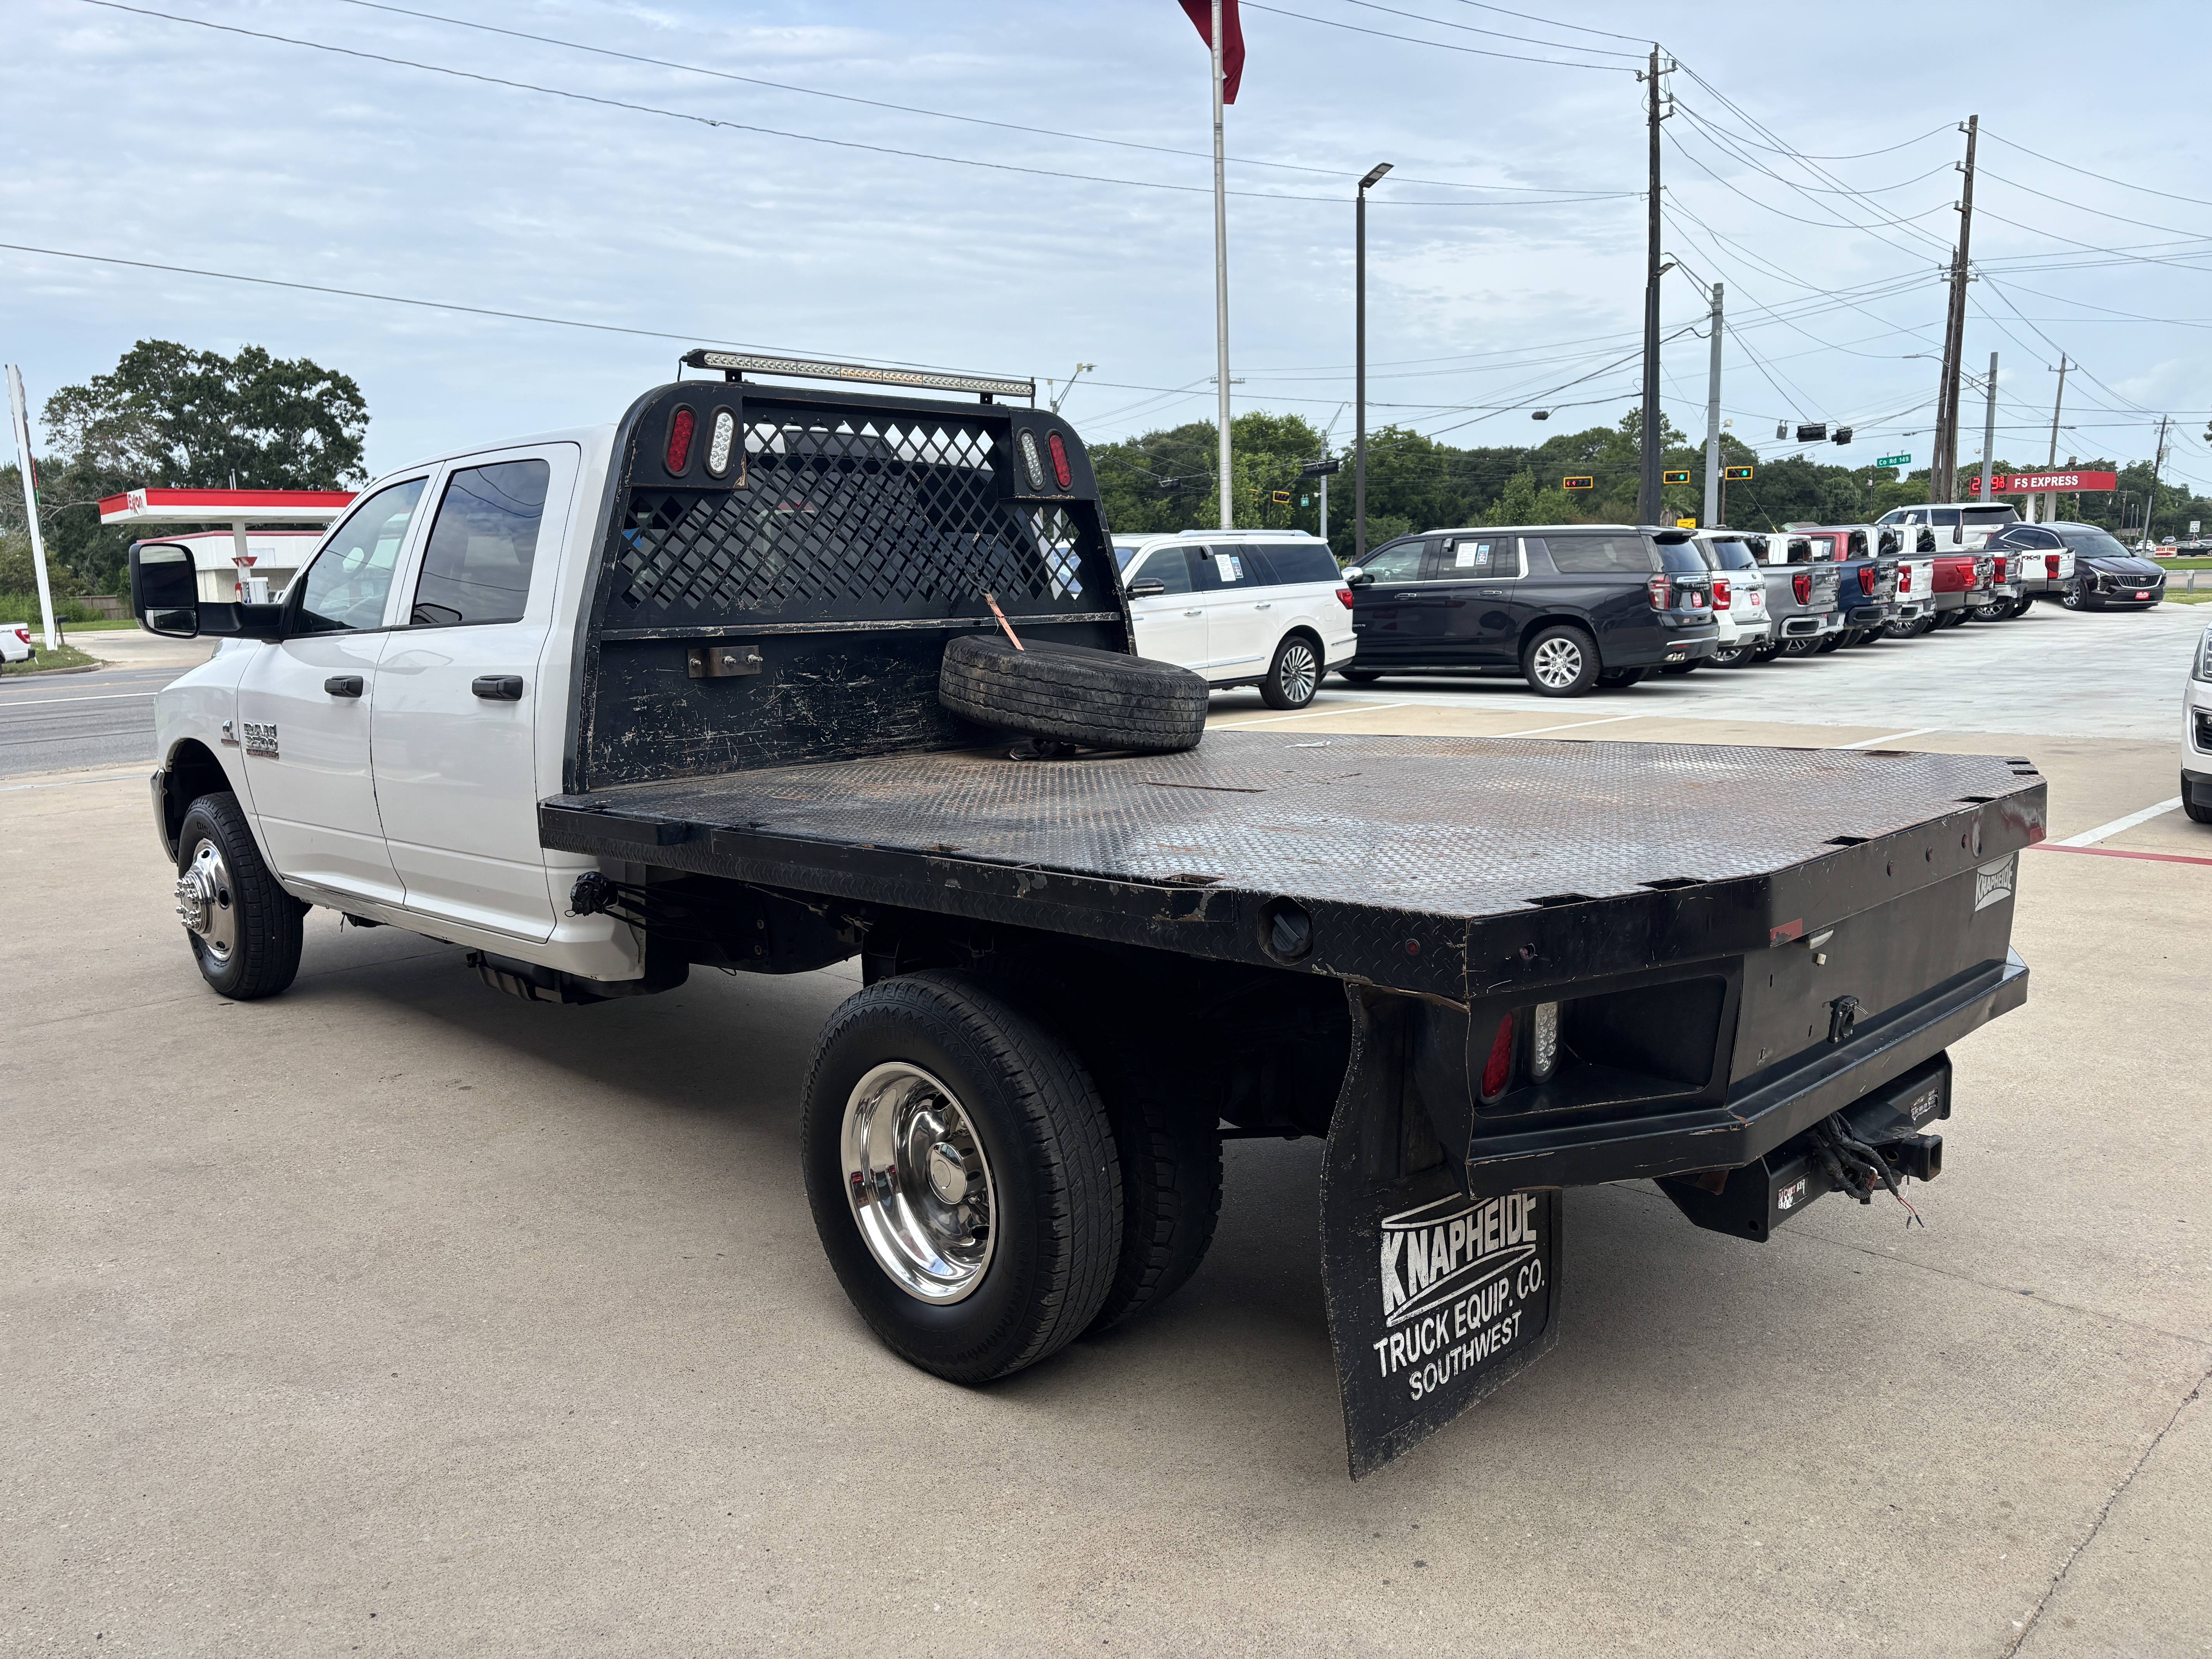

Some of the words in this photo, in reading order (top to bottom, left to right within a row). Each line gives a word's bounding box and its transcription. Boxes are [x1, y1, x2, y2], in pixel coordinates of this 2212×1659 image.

[1972, 476, 1999, 490] 2.9
[2014, 477, 2028, 488] FS
[2031, 475, 2078, 487] EXPRESS
[128, 494, 144, 515] Exxon
[244, 722, 277, 737] RAM
[245, 735, 278, 750] 3500
[1975, 857, 2013, 907] KNAPHEIDE
[1380, 1193, 1537, 1316] KNAPHEIDE
[1373, 1309, 1449, 1377] TRUCK
[1455, 1277, 1513, 1339] EQUIP.
[1517, 1259, 1545, 1300] CO.
[1410, 1310, 1522, 1401] SOUTHWEST
